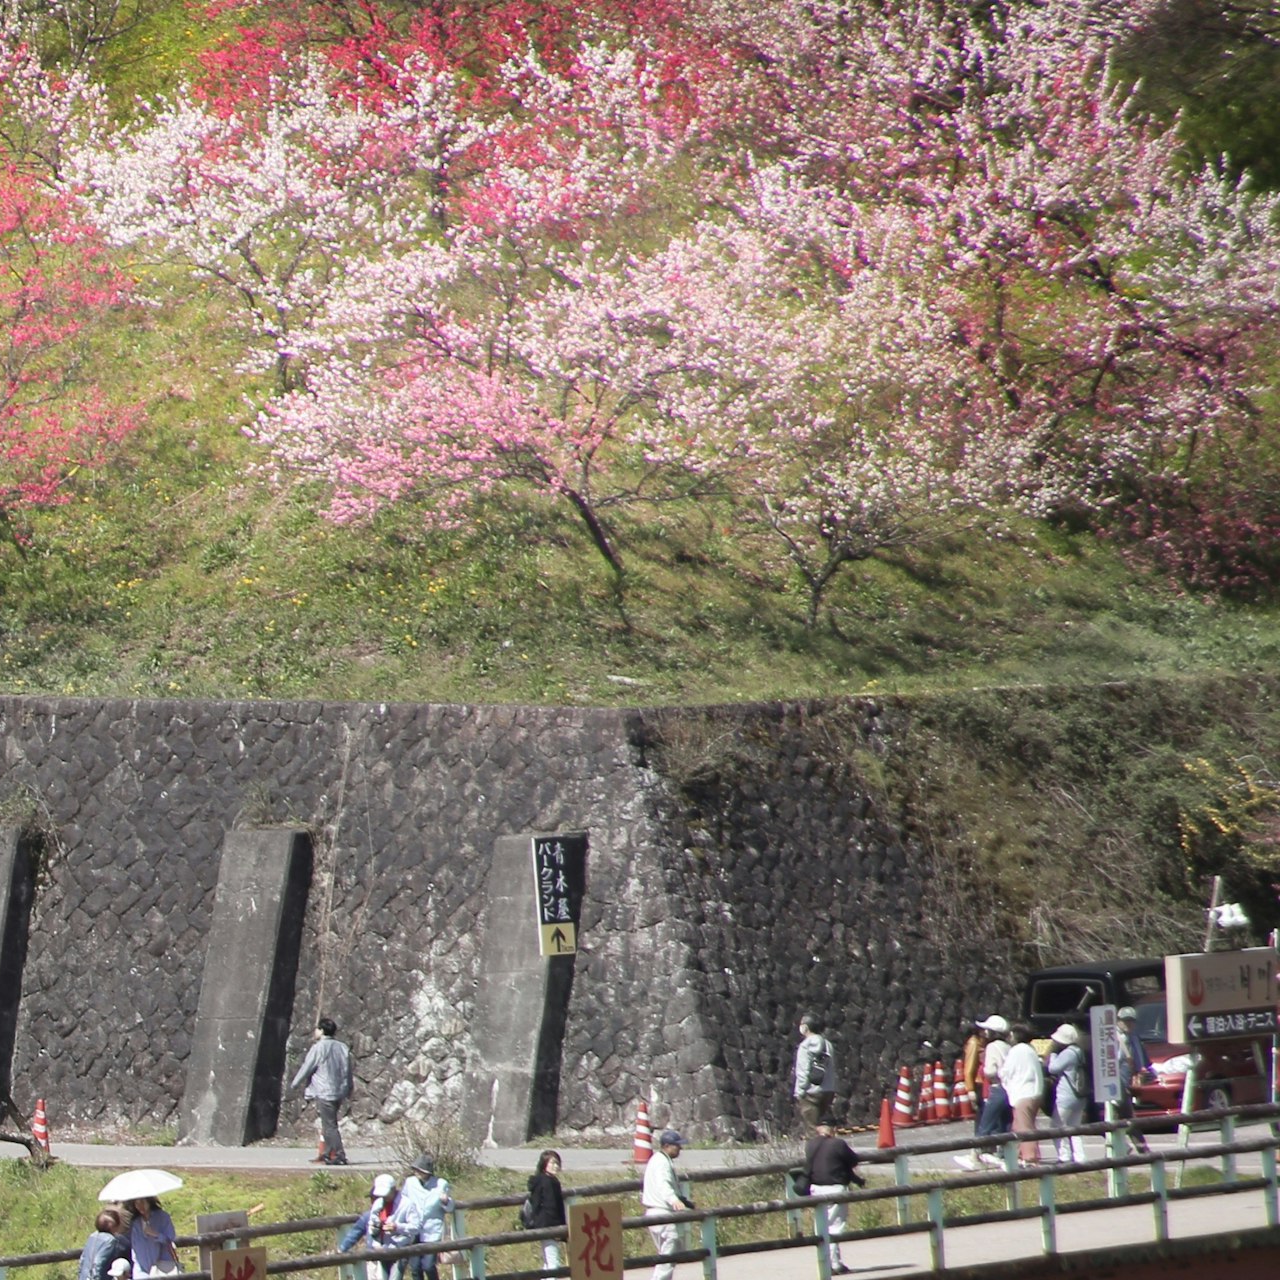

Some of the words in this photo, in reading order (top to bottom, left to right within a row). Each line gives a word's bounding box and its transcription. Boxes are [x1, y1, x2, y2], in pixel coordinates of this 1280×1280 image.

[538, 841, 555, 922] パークランド
[552, 841, 571, 921] 青木屋
[577, 1206, 615, 1278] 花
